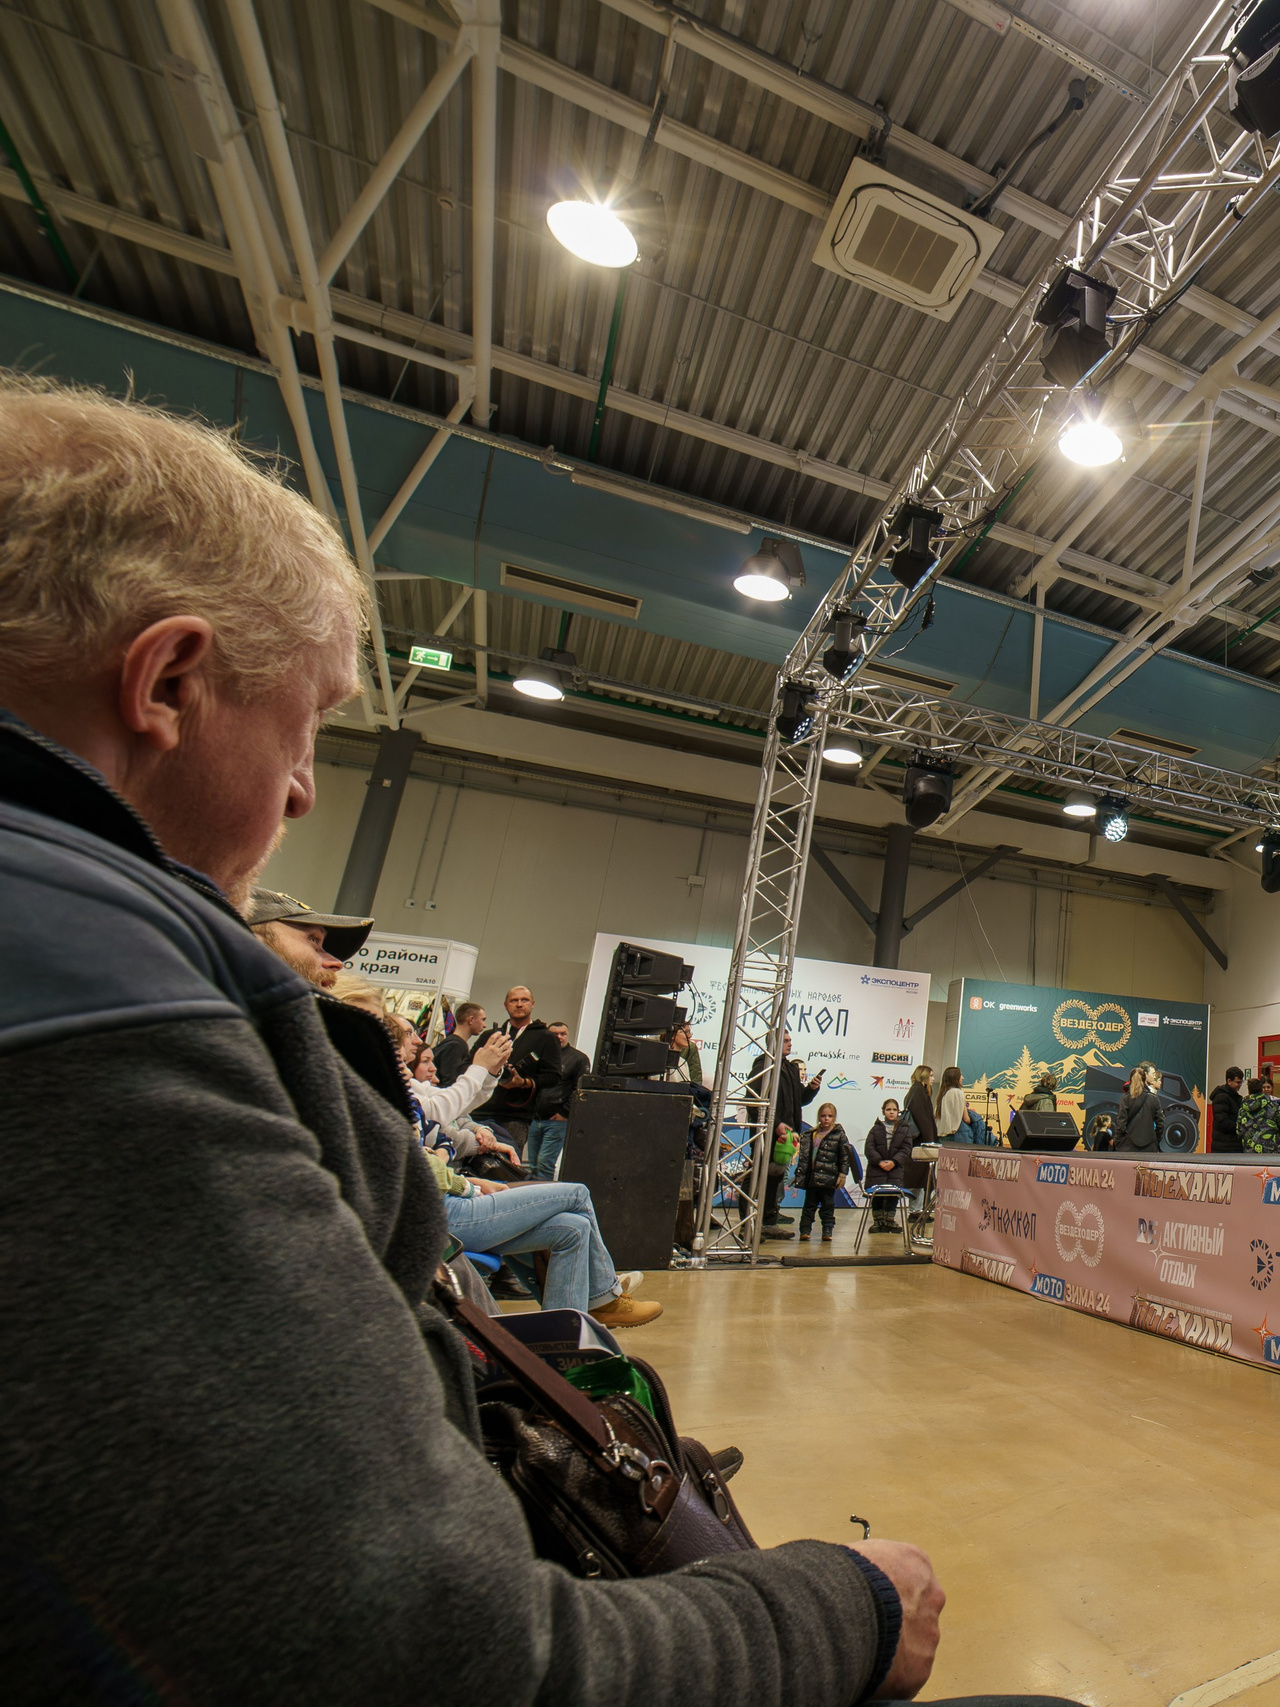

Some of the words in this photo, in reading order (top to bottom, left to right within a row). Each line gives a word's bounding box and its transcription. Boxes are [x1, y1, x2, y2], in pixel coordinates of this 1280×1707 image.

[360, 961, 400, 974] края
[376, 949, 438, 964] района
[871, 978, 920, 988] ЭКСПОЦЕНТР
[999, 1003, 1038, 1012] greenworks
[1060, 1018, 1124, 1032] ВЕЗДЕХОДЕР
[873, 1052, 909, 1062] Версия
[967, 1156, 1021, 1182] ПОЕХАЛИ
[1039, 1163, 1068, 1183] МОТО
[1069, 1168, 1099, 1188] ЗИМА
[1100, 1169, 1115, 1189] 24
[1134, 1168, 1234, 1205] ПОЕХАЛИ
[978, 1198, 1037, 1241] ЭТНОСКОП
[1060, 1224, 1099, 1241] ВЕЗДЕХОДЕР
[1162, 1221, 1225, 1256] АКТИВНЫЙ
[1159, 1259, 1197, 1288] ОТДЫХ
[1034, 1275, 1064, 1299] МОТО
[1064, 1283, 1095, 1310] ЗИМА
[1097, 1292, 1110, 1314] 24
[1130, 1299, 1234, 1353] ПОЕХАЛИ
